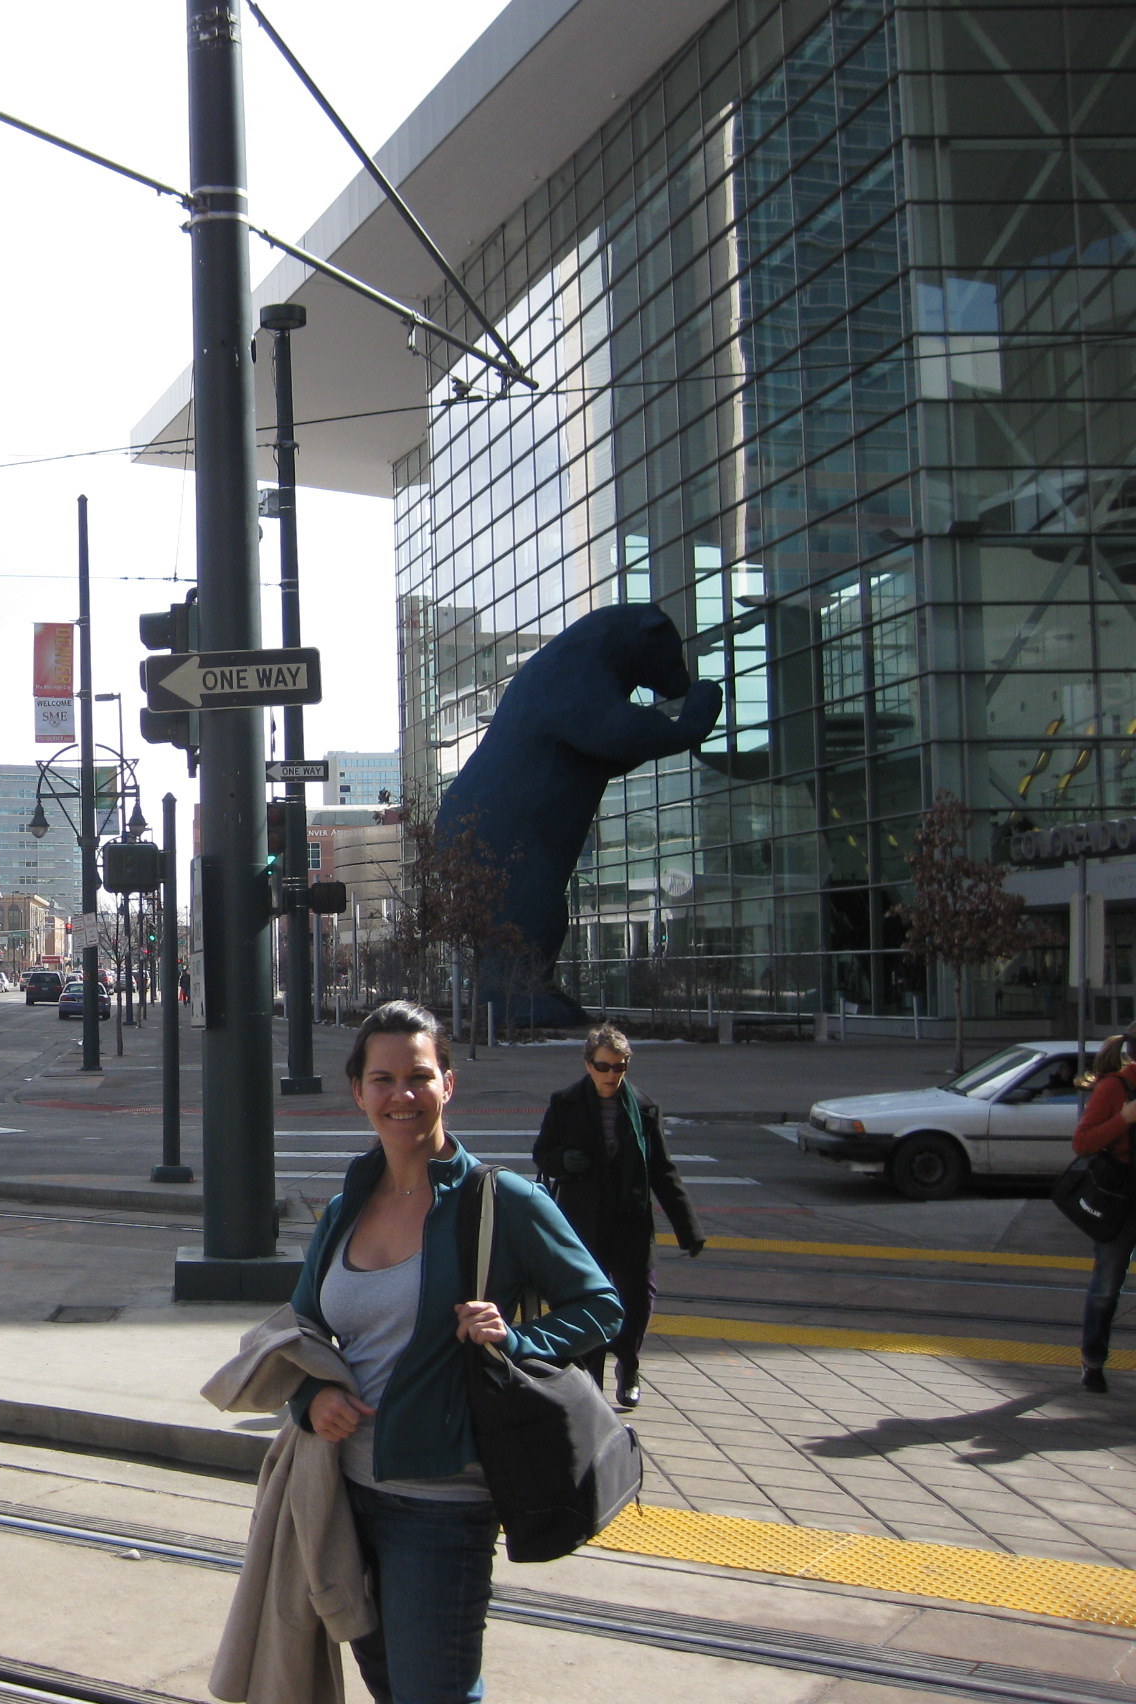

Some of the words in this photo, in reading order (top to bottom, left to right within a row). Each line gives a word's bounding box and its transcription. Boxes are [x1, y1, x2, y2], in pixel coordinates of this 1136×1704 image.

[54, 627, 71, 686] DENVER
[202, 668, 249, 691] ONE
[256, 666, 301, 688] WAY
[42, 711, 68, 722] SME
[282, 767, 300, 776] ONE
[304, 766, 322, 776] WAY
[1010, 819, 1131, 862] COLORADO
